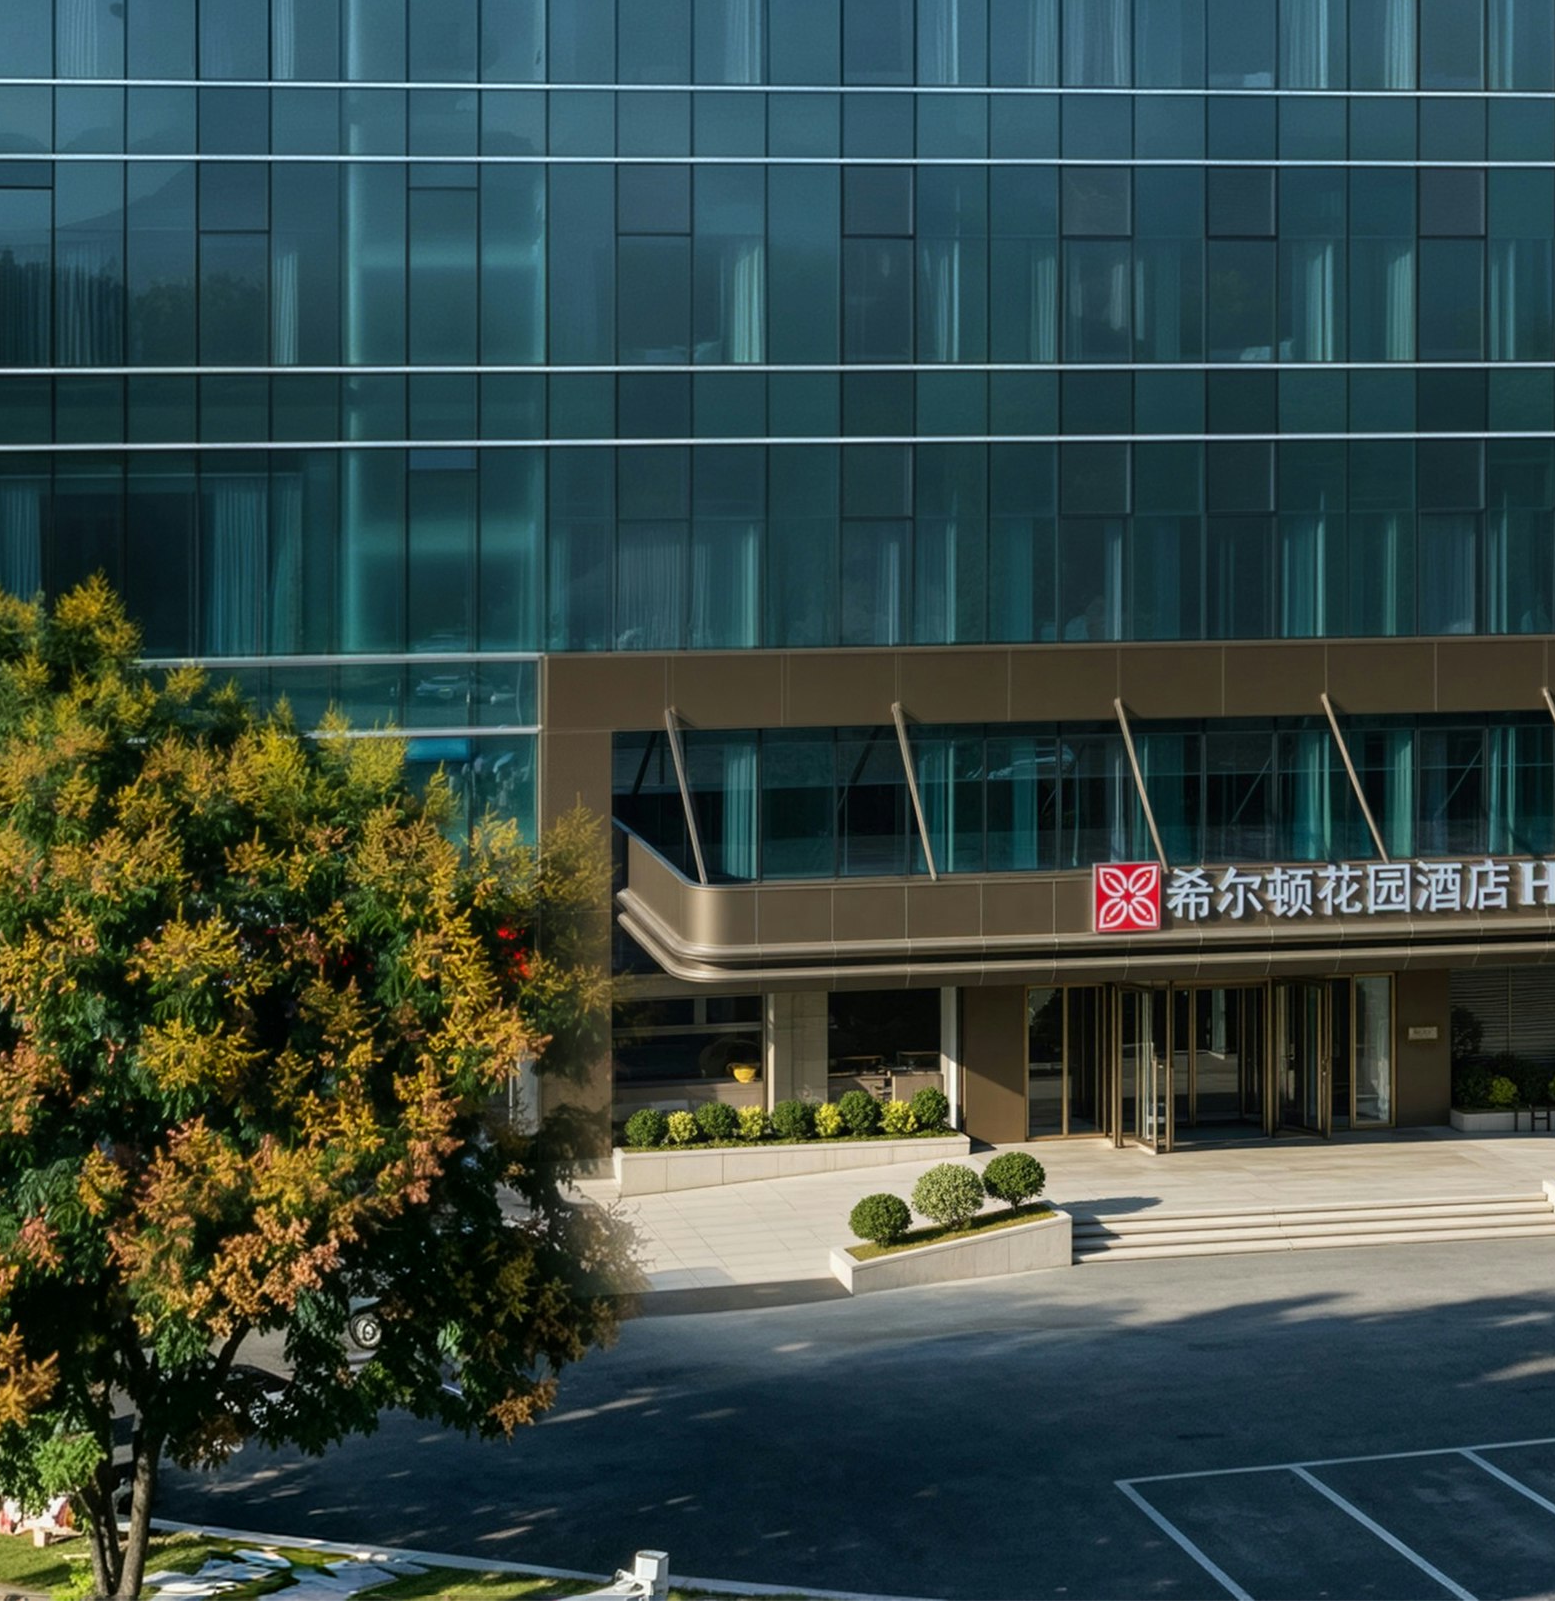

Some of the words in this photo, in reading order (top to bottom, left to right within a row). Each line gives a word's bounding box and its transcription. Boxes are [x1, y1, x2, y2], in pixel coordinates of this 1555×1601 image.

[1166, 858, 1511, 921] 希尔顿花园酒店
